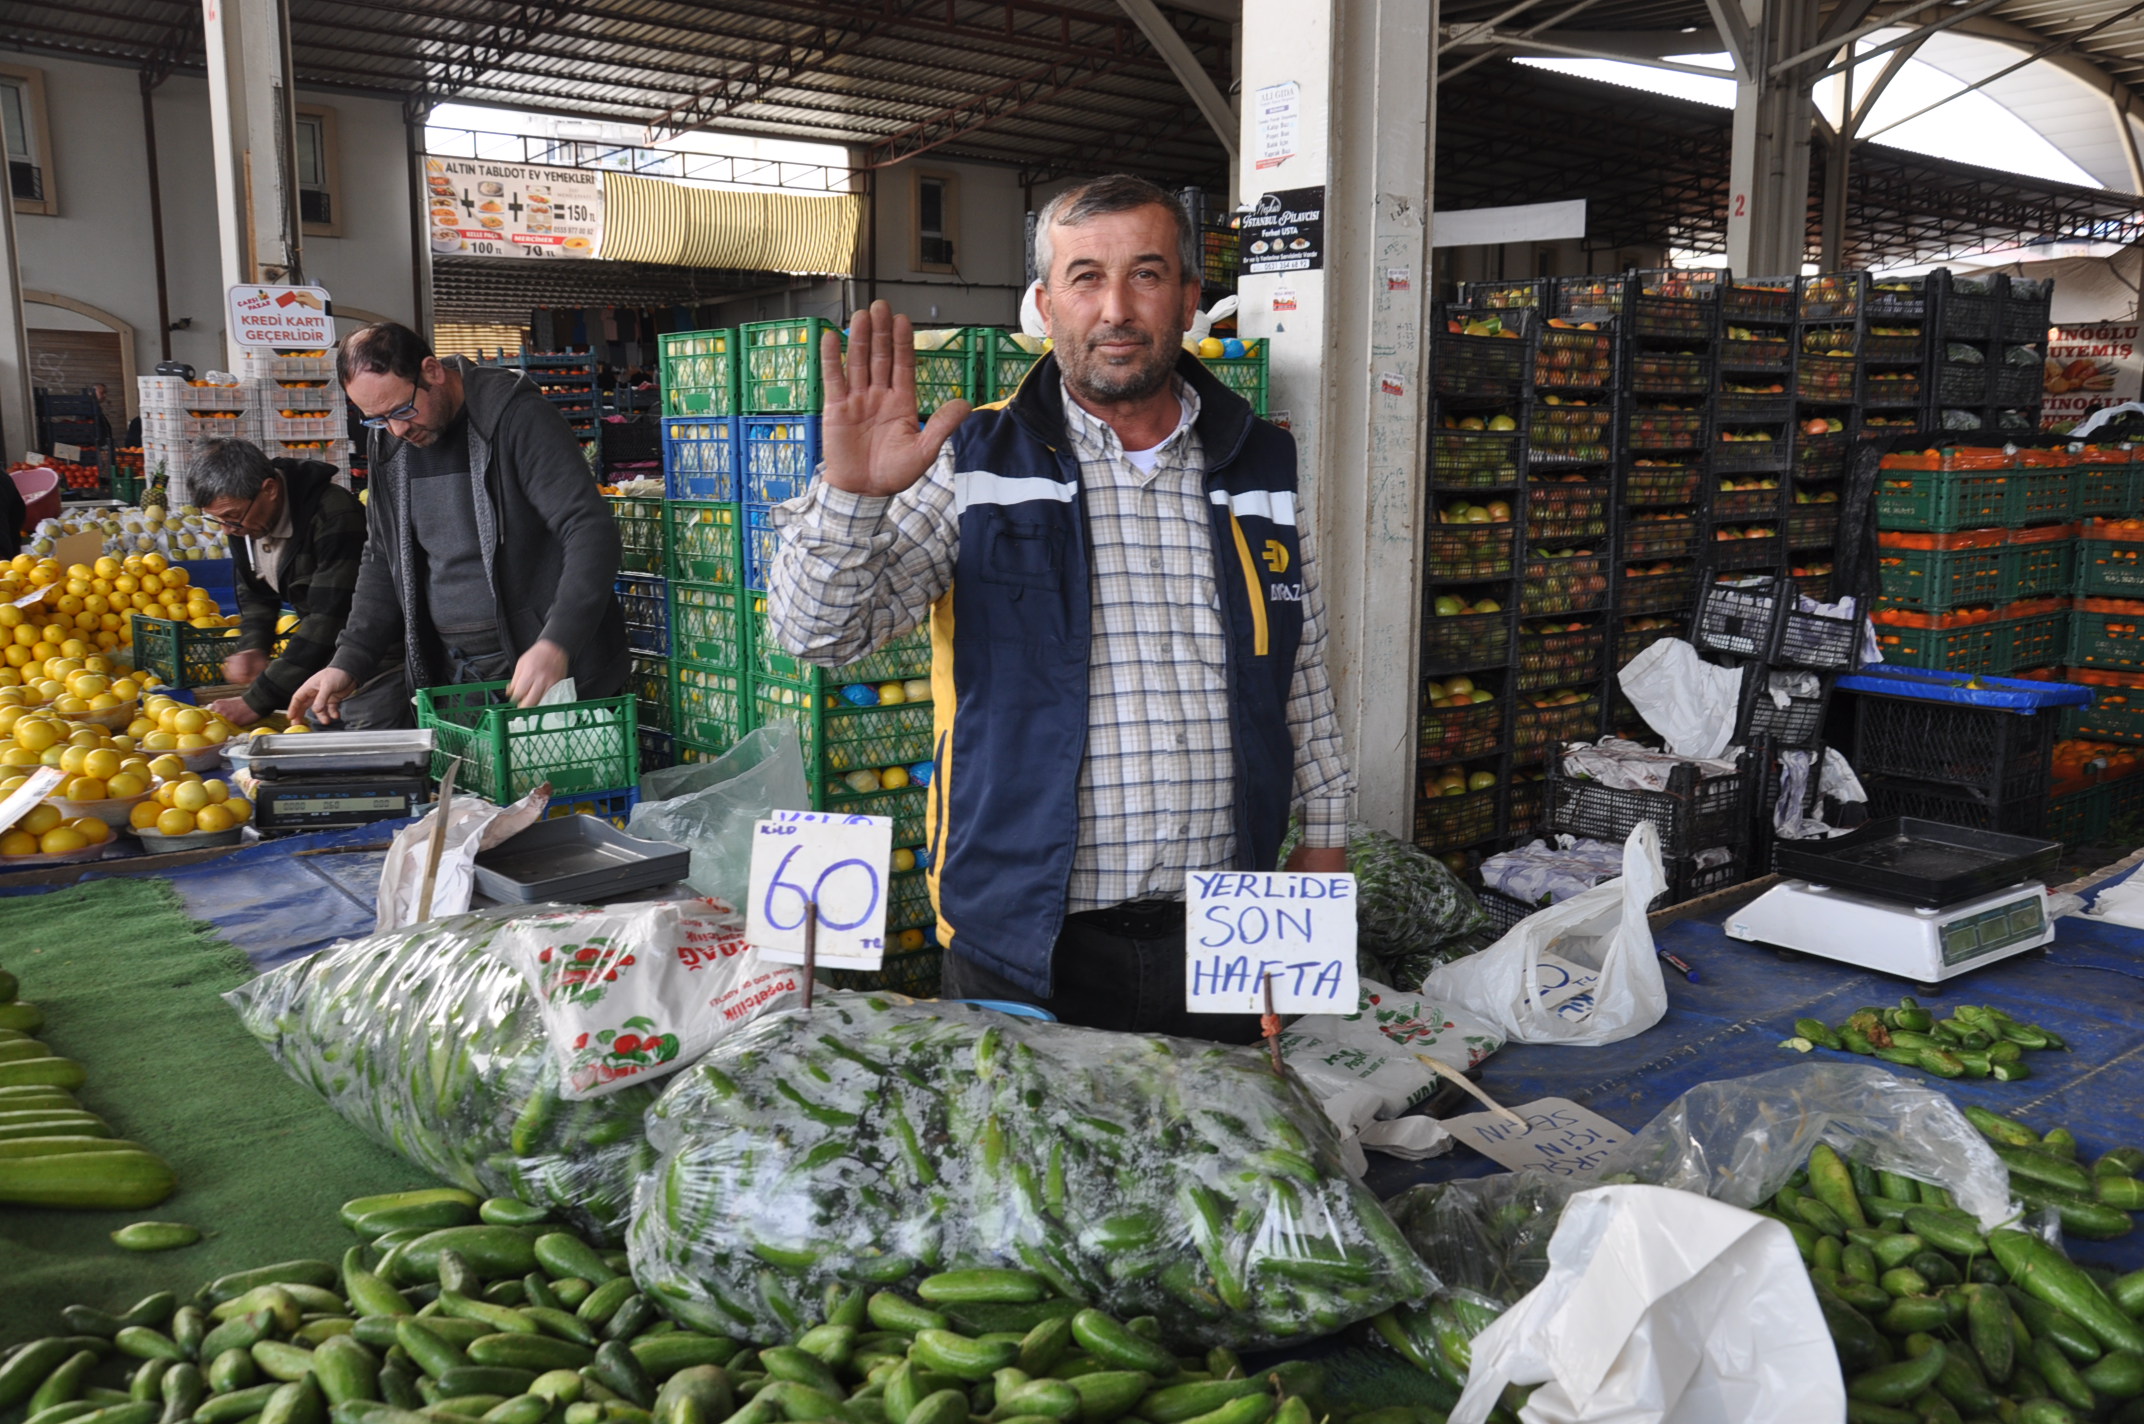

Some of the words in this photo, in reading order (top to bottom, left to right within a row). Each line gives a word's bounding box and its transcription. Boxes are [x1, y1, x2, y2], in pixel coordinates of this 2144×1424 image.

[445, 163, 478, 176] ALTIN
[479, 165, 526, 179] TABLDOT
[529, 169, 541, 180] EV
[567, 204, 588, 222] 150
[589, 213, 596, 222] TL
[1735, 194, 1745, 217] 2
[513, 234, 554, 243] MERCİMEK
[1281, 226, 1298, 236] USTA
[471, 242, 494, 255] 100
[495, 247, 503, 255] TL
[522, 245, 544, 257] 70
[248, 301, 271, 310] PAZAR
[241, 313, 282, 326] KREDİ
[286, 316, 325, 327] KARTI
[245, 328, 324, 343] GEÇERLİDİR
[2048, 324, 2140, 341] İNOĞLU
[764, 844, 880, 931] 60
[1193, 873, 1351, 900] YERLİDE
[1200, 905, 1312, 948] SON
[1193, 955, 1343, 999] HAFTA
[722, 979, 796, 1021] Poşetcilik
[1534, 1128, 1617, 1158] İÇİN
